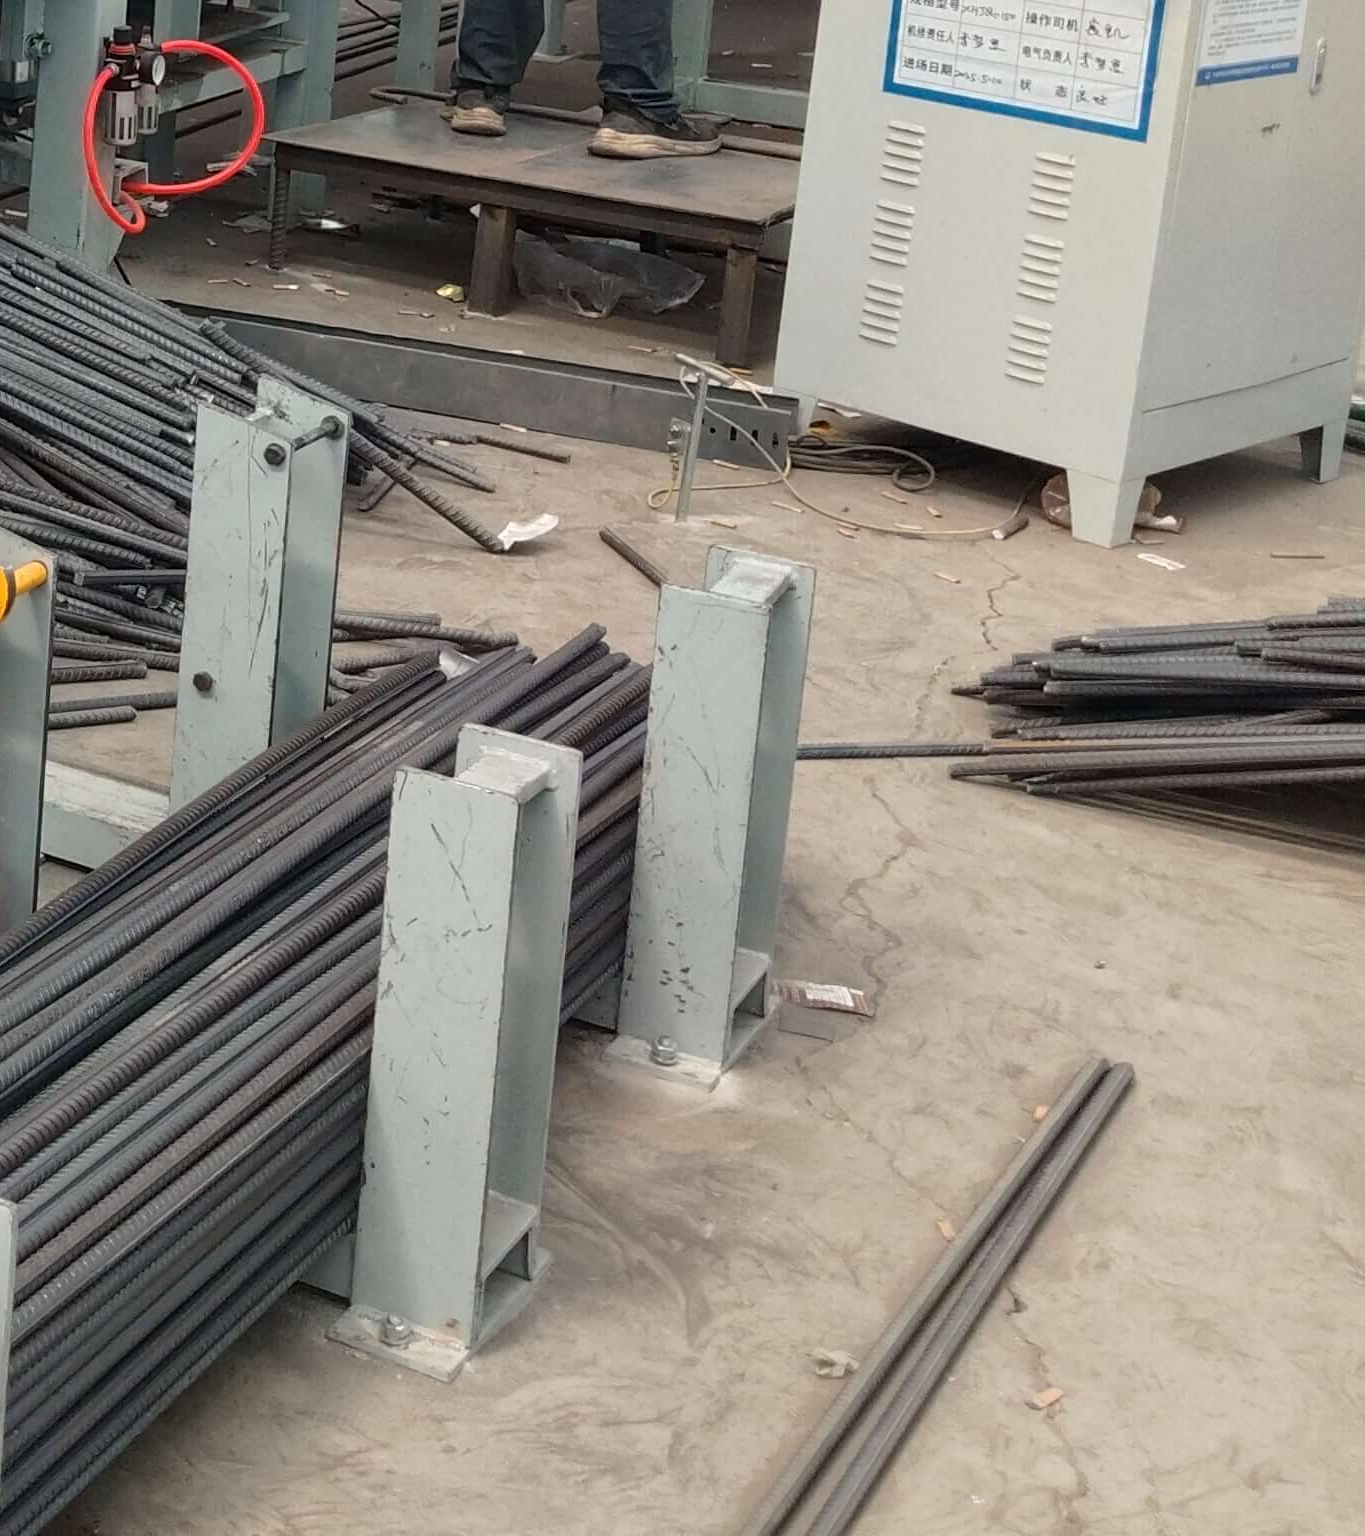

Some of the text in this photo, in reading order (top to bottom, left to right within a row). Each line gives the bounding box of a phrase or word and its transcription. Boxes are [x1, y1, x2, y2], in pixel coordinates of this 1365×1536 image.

[1026, 11, 1078, 32] 操作司机
[1022, 46, 1072, 65] 电气负责人
[902, 56, 953, 76] 进场日期
